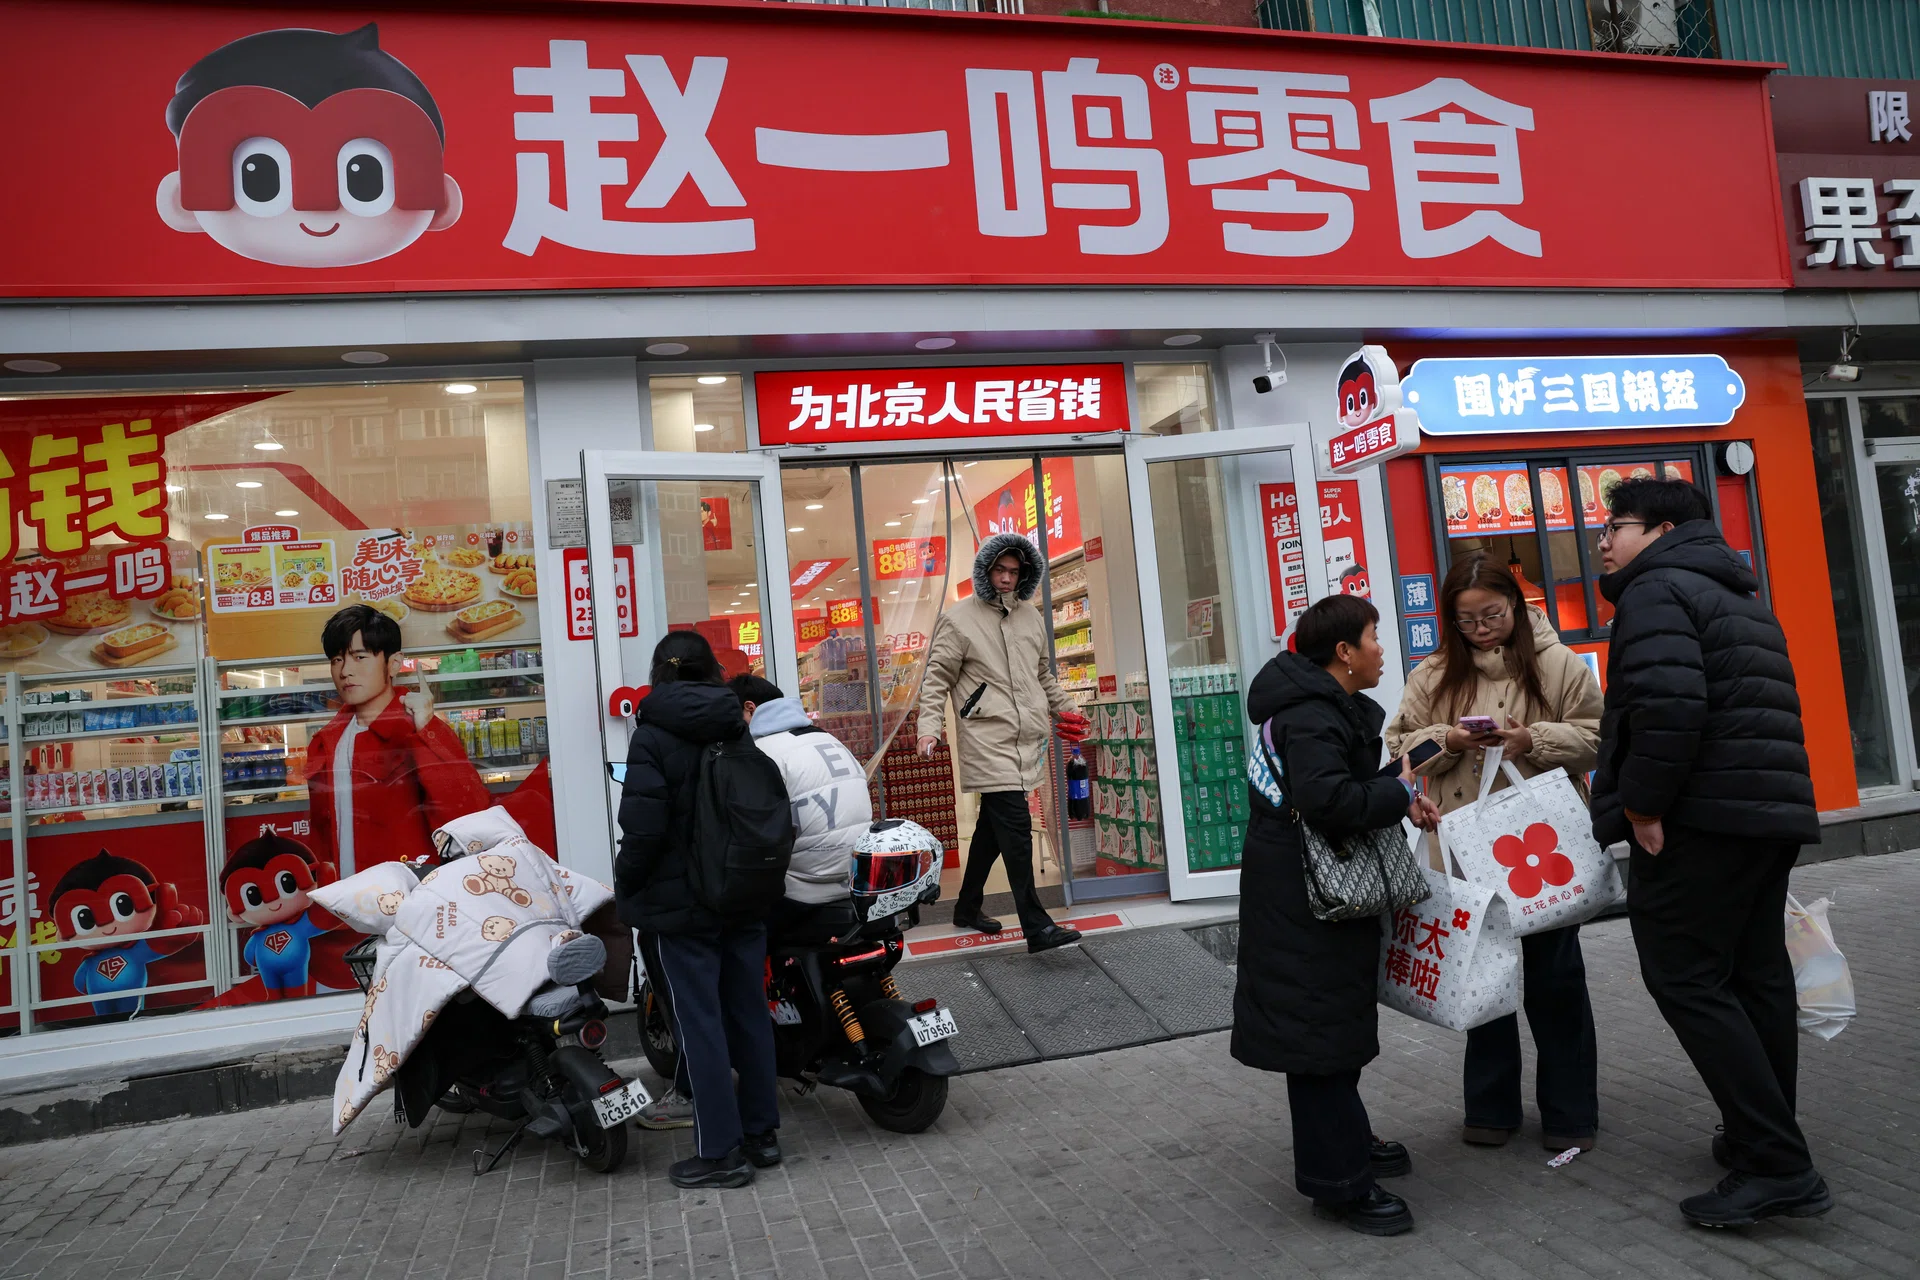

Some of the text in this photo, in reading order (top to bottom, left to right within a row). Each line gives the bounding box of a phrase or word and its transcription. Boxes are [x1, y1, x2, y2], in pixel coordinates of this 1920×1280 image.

[1868, 91, 1913, 142] 限
[502, 39, 1543, 258] 赵一鸣零食
[788, 378, 1100, 431] 为北京人民省钱
[1333, 422, 1392, 463] 赵一鸣零食
[0, 418, 162, 560] 钱
[250, 530, 291, 542] 爆品推荐
[353, 538, 413, 566] 美味
[0, 548, 164, 622] 赵一鸣
[341, 559, 425, 596] 随心享
[251, 590, 273, 605] 8.8
[312, 586, 334, 602] 6.9
[1411, 623, 1433, 647] 脆
[259, 820, 310, 838] 赵一鸣
[889, 844, 909, 853] WHAT
[436, 905, 445, 939] TEDDY
[448, 901, 457, 927] BEAR
[1395, 908, 1450, 960] 你太
[1385, 944, 1441, 1001] 棒啦
[917, 1021, 956, 1043] U79562
[920, 1015, 944, 1028] 北京
[601, 1092, 647, 1126] PC3510
[603, 1089, 632, 1110] 北京
